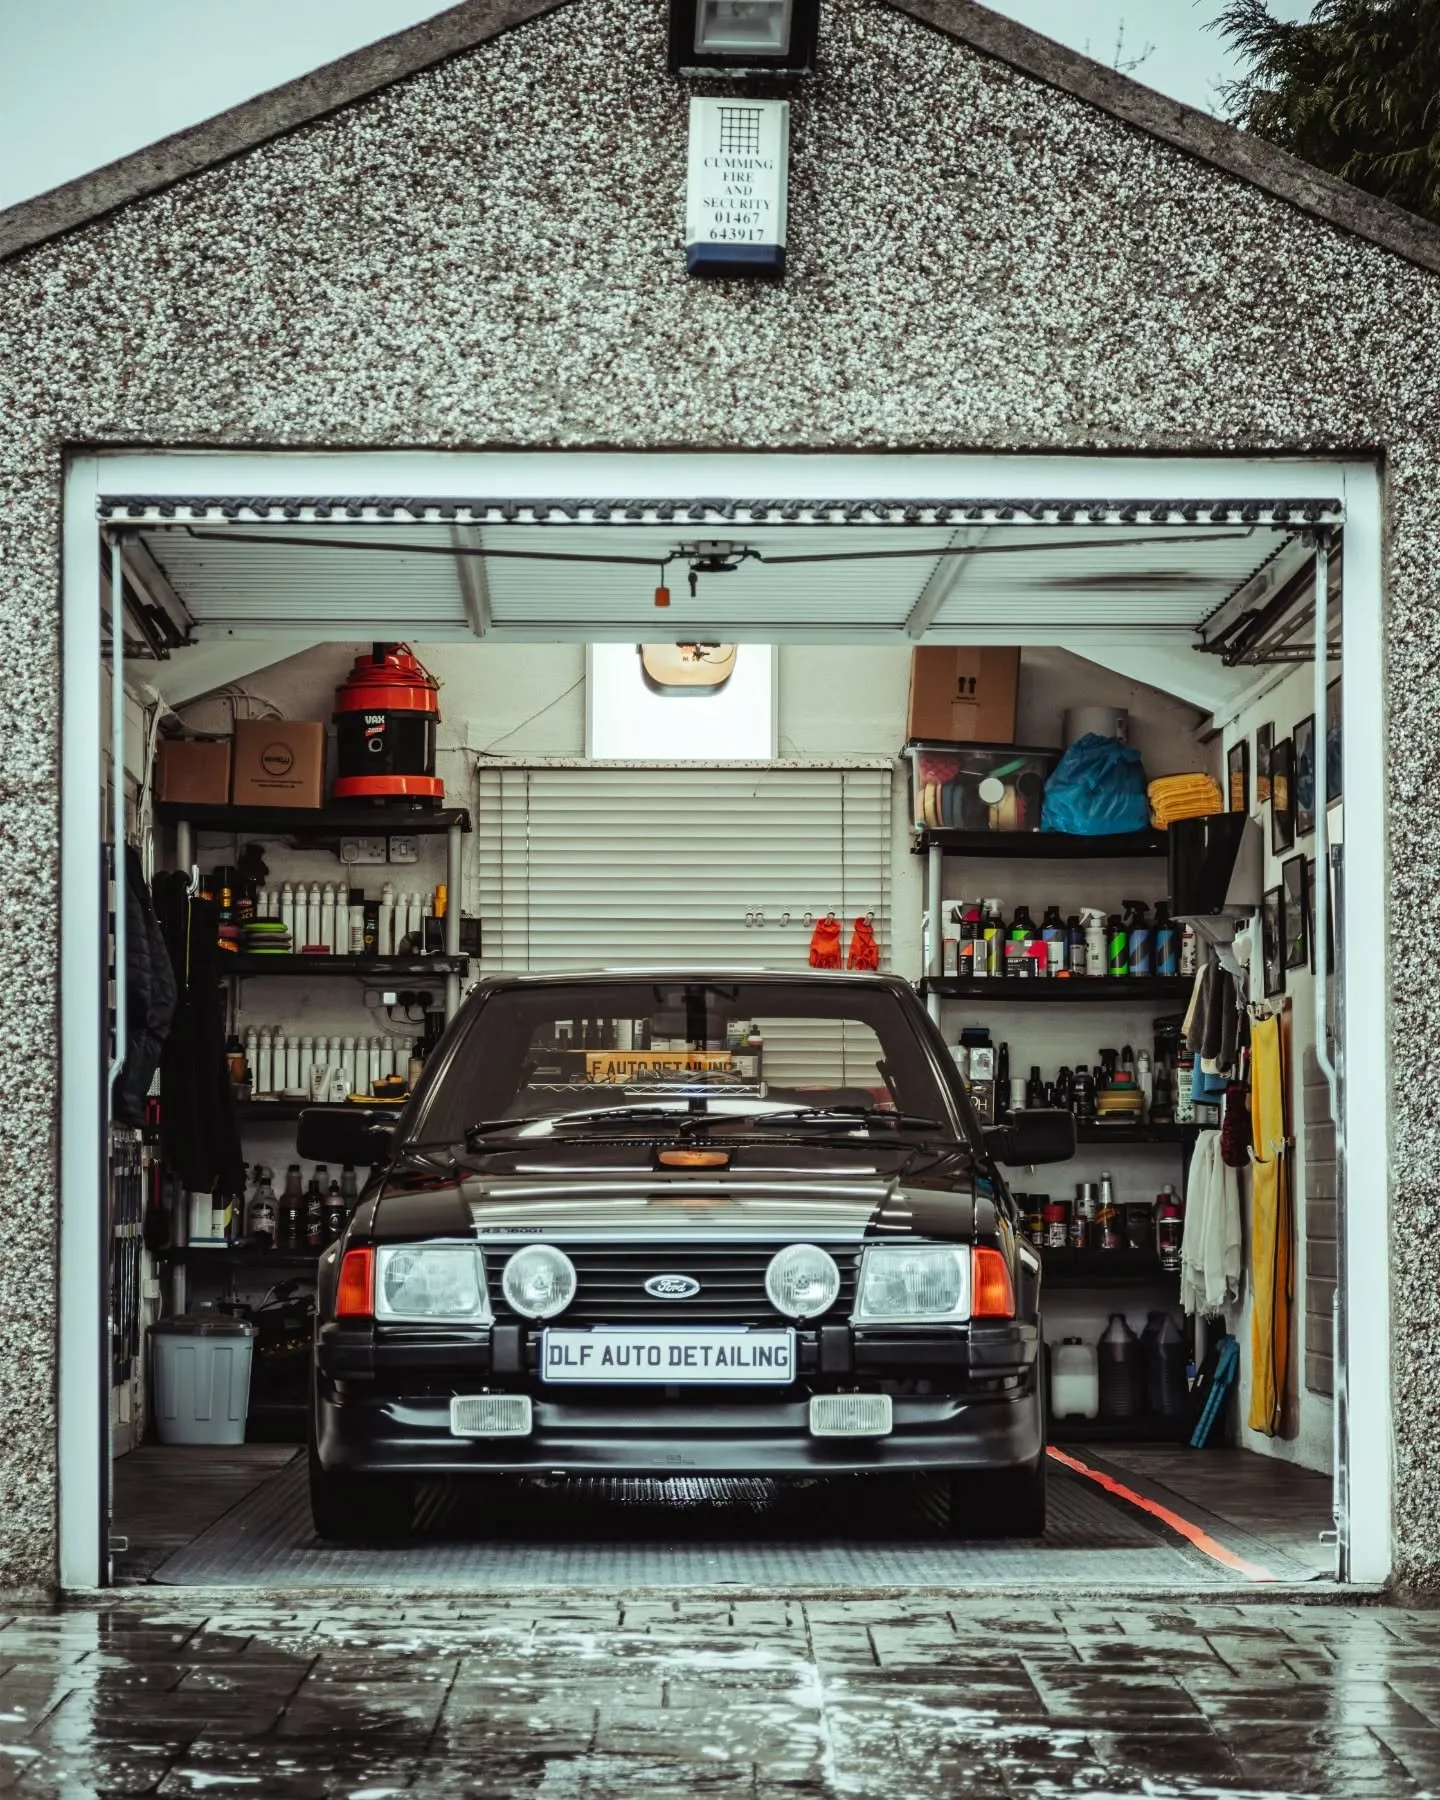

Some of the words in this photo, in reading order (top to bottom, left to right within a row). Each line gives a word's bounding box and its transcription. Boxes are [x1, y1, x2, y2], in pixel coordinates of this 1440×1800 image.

[704, 157, 773, 169] CUMMING
[723, 171, 754, 182] FIRE
[725, 185, 753, 196] AND
[703, 197, 770, 210] SECURITY
[715, 211, 760, 224] 01467
[709, 227, 764, 241] 643917
[365, 715, 385, 725] VAX
[607, 1060, 648, 1076] AUTO
[656, 1279, 687, 1292] Ford
[549, 1344, 594, 1367] DLF
[601, 1344, 662, 1367] AUTO
[668, 1345, 789, 1368] DETAILING
